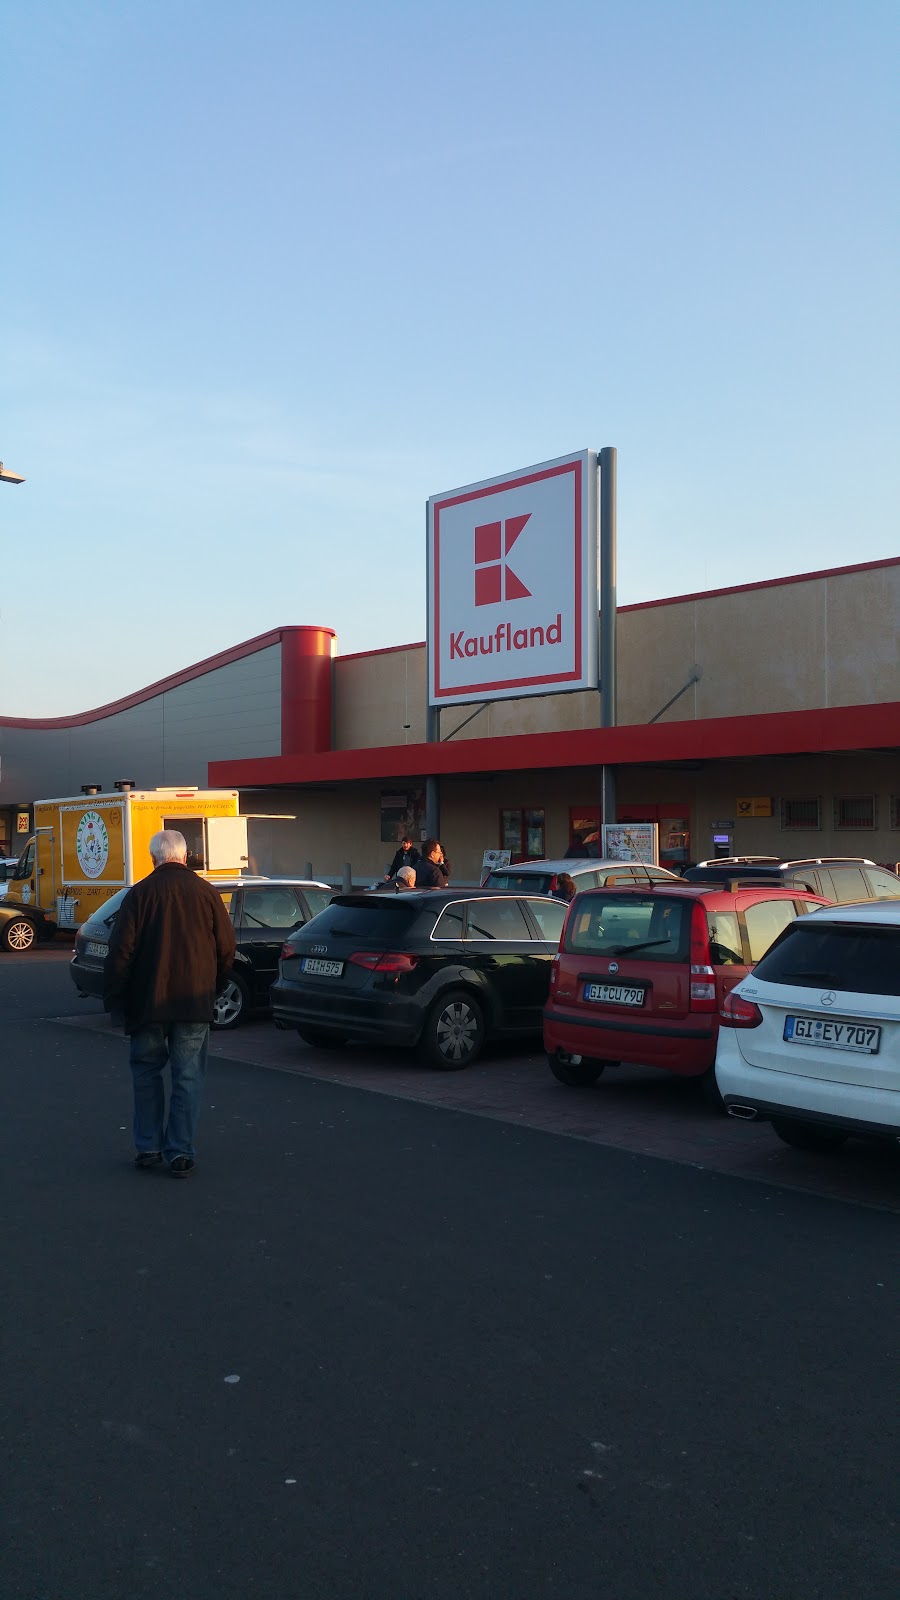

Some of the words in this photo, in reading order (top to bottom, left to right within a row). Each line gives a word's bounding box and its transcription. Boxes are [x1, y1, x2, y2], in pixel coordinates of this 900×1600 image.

[450, 613, 562, 660] Kaufland
[307, 959, 317, 971] GI
[326, 962, 340, 974] 575
[590, 985, 602, 999] GI
[608, 987, 622, 1000] CU
[623, 988, 644, 1003] 790
[795, 1020, 813, 1038] GI
[822, 1023, 844, 1041] EY
[847, 1027, 876, 1046] 707
